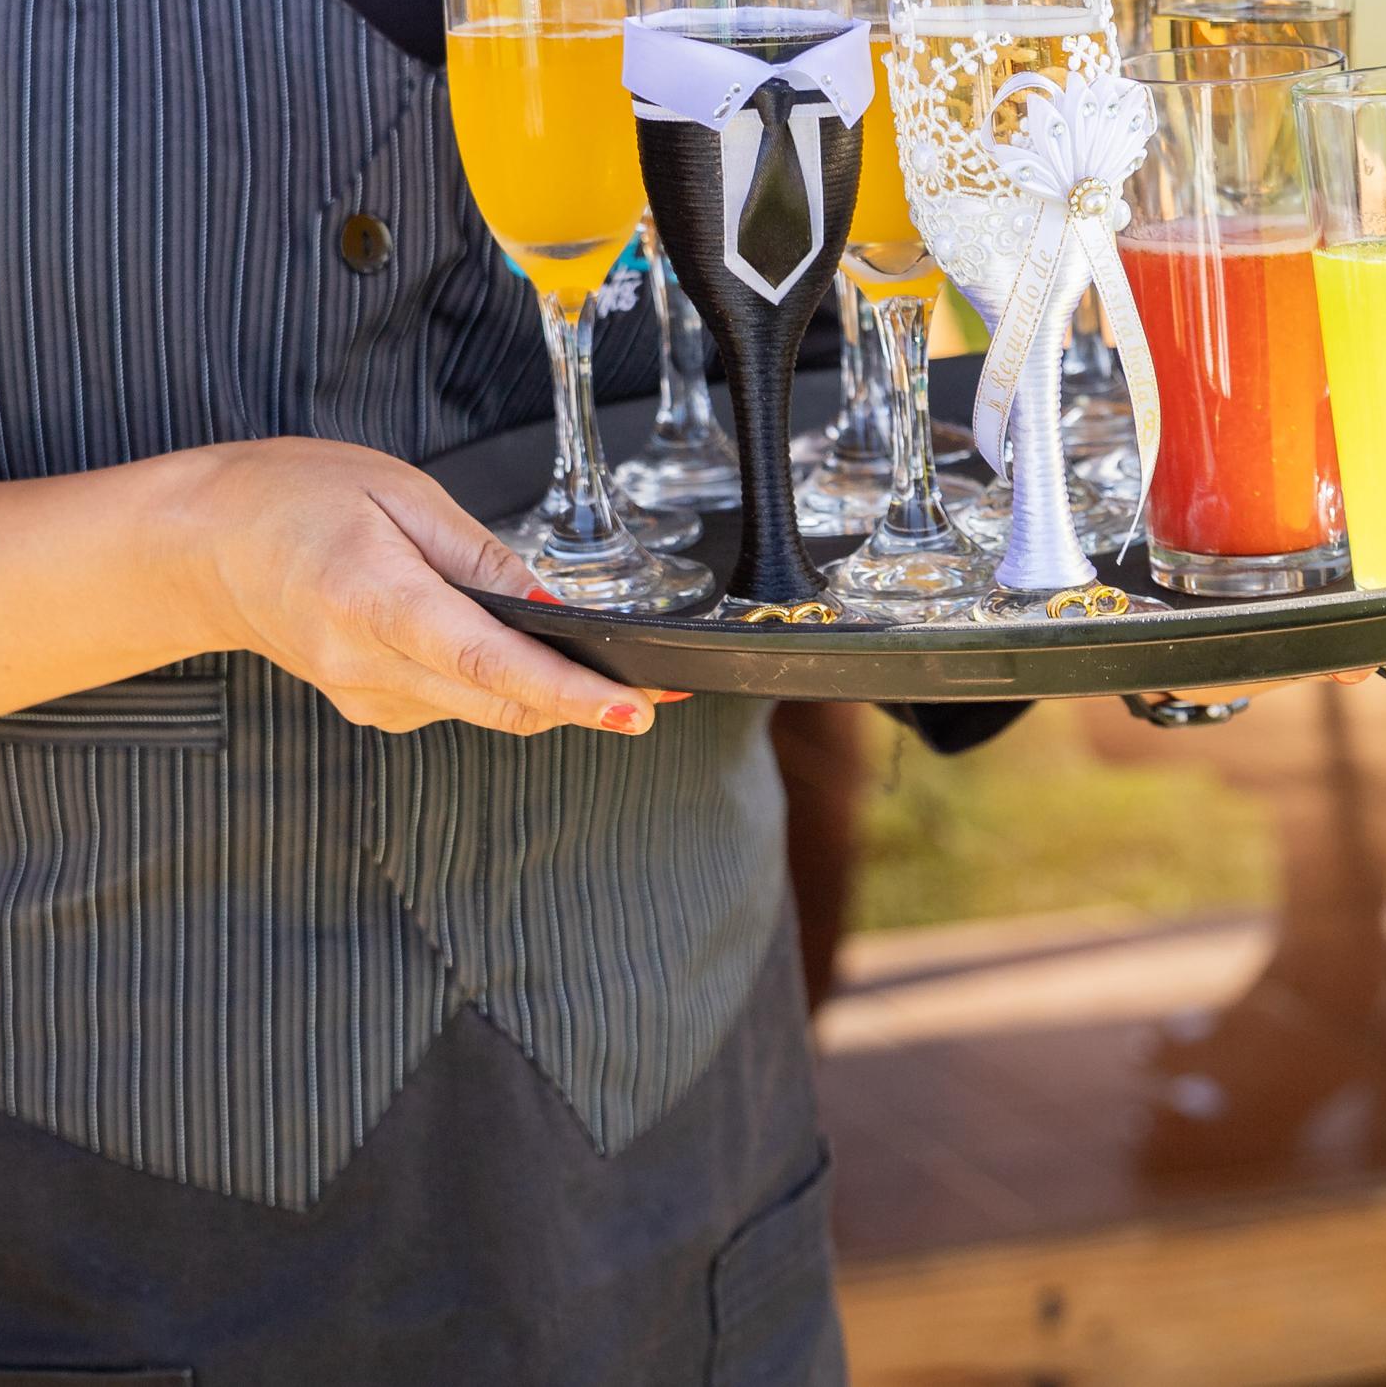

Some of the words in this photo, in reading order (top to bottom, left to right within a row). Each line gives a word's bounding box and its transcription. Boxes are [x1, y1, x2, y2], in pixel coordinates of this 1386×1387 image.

[990, 284, 1040, 390] Recuerdo
[1029, 249, 1053, 281] de
[1094, 240, 1135, 338] Nuestra
